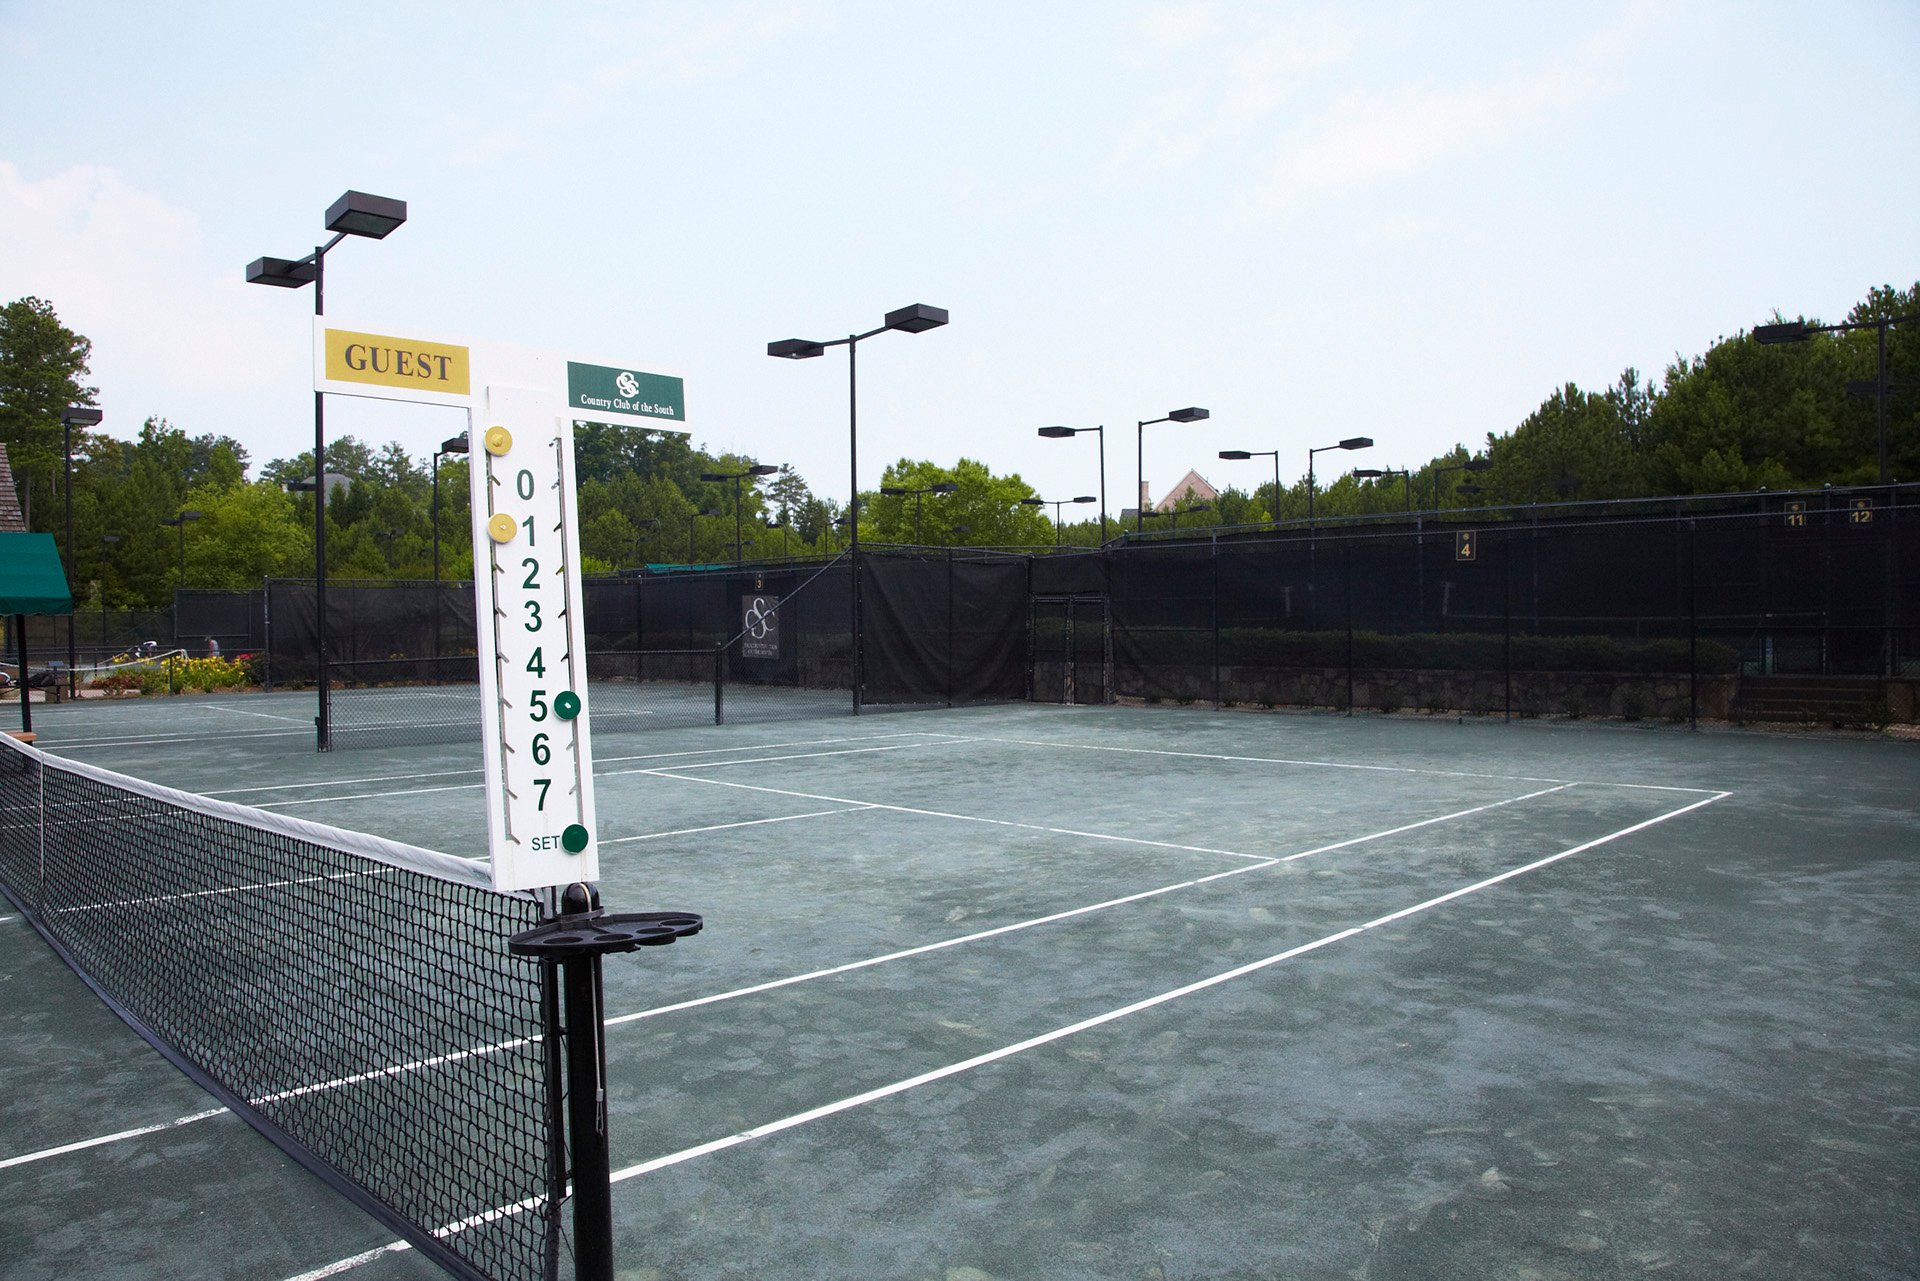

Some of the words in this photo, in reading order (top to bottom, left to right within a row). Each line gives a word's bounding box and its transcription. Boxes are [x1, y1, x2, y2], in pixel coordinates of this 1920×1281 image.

[345, 343, 452, 381] GUEST
[581, 394, 611, 409] Country
[613, 398, 630, 410] Club
[632, 401, 640, 411] of
[641, 402, 652, 412] the
[654, 404, 674, 415] South
[516, 469, 535, 501] 0
[522, 515, 535, 546] 1
[1788, 514, 1803, 526] 11
[1851, 511, 1870, 522] 12
[1461, 543, 1471, 557] 4
[521, 557, 541, 589] 2
[524, 600, 542, 632] 3
[526, 647, 546, 678] 4
[529, 690, 548, 722] 5
[532, 732, 551, 766] 6
[533, 779, 552, 811] 7
[531, 835, 560, 851] SET
